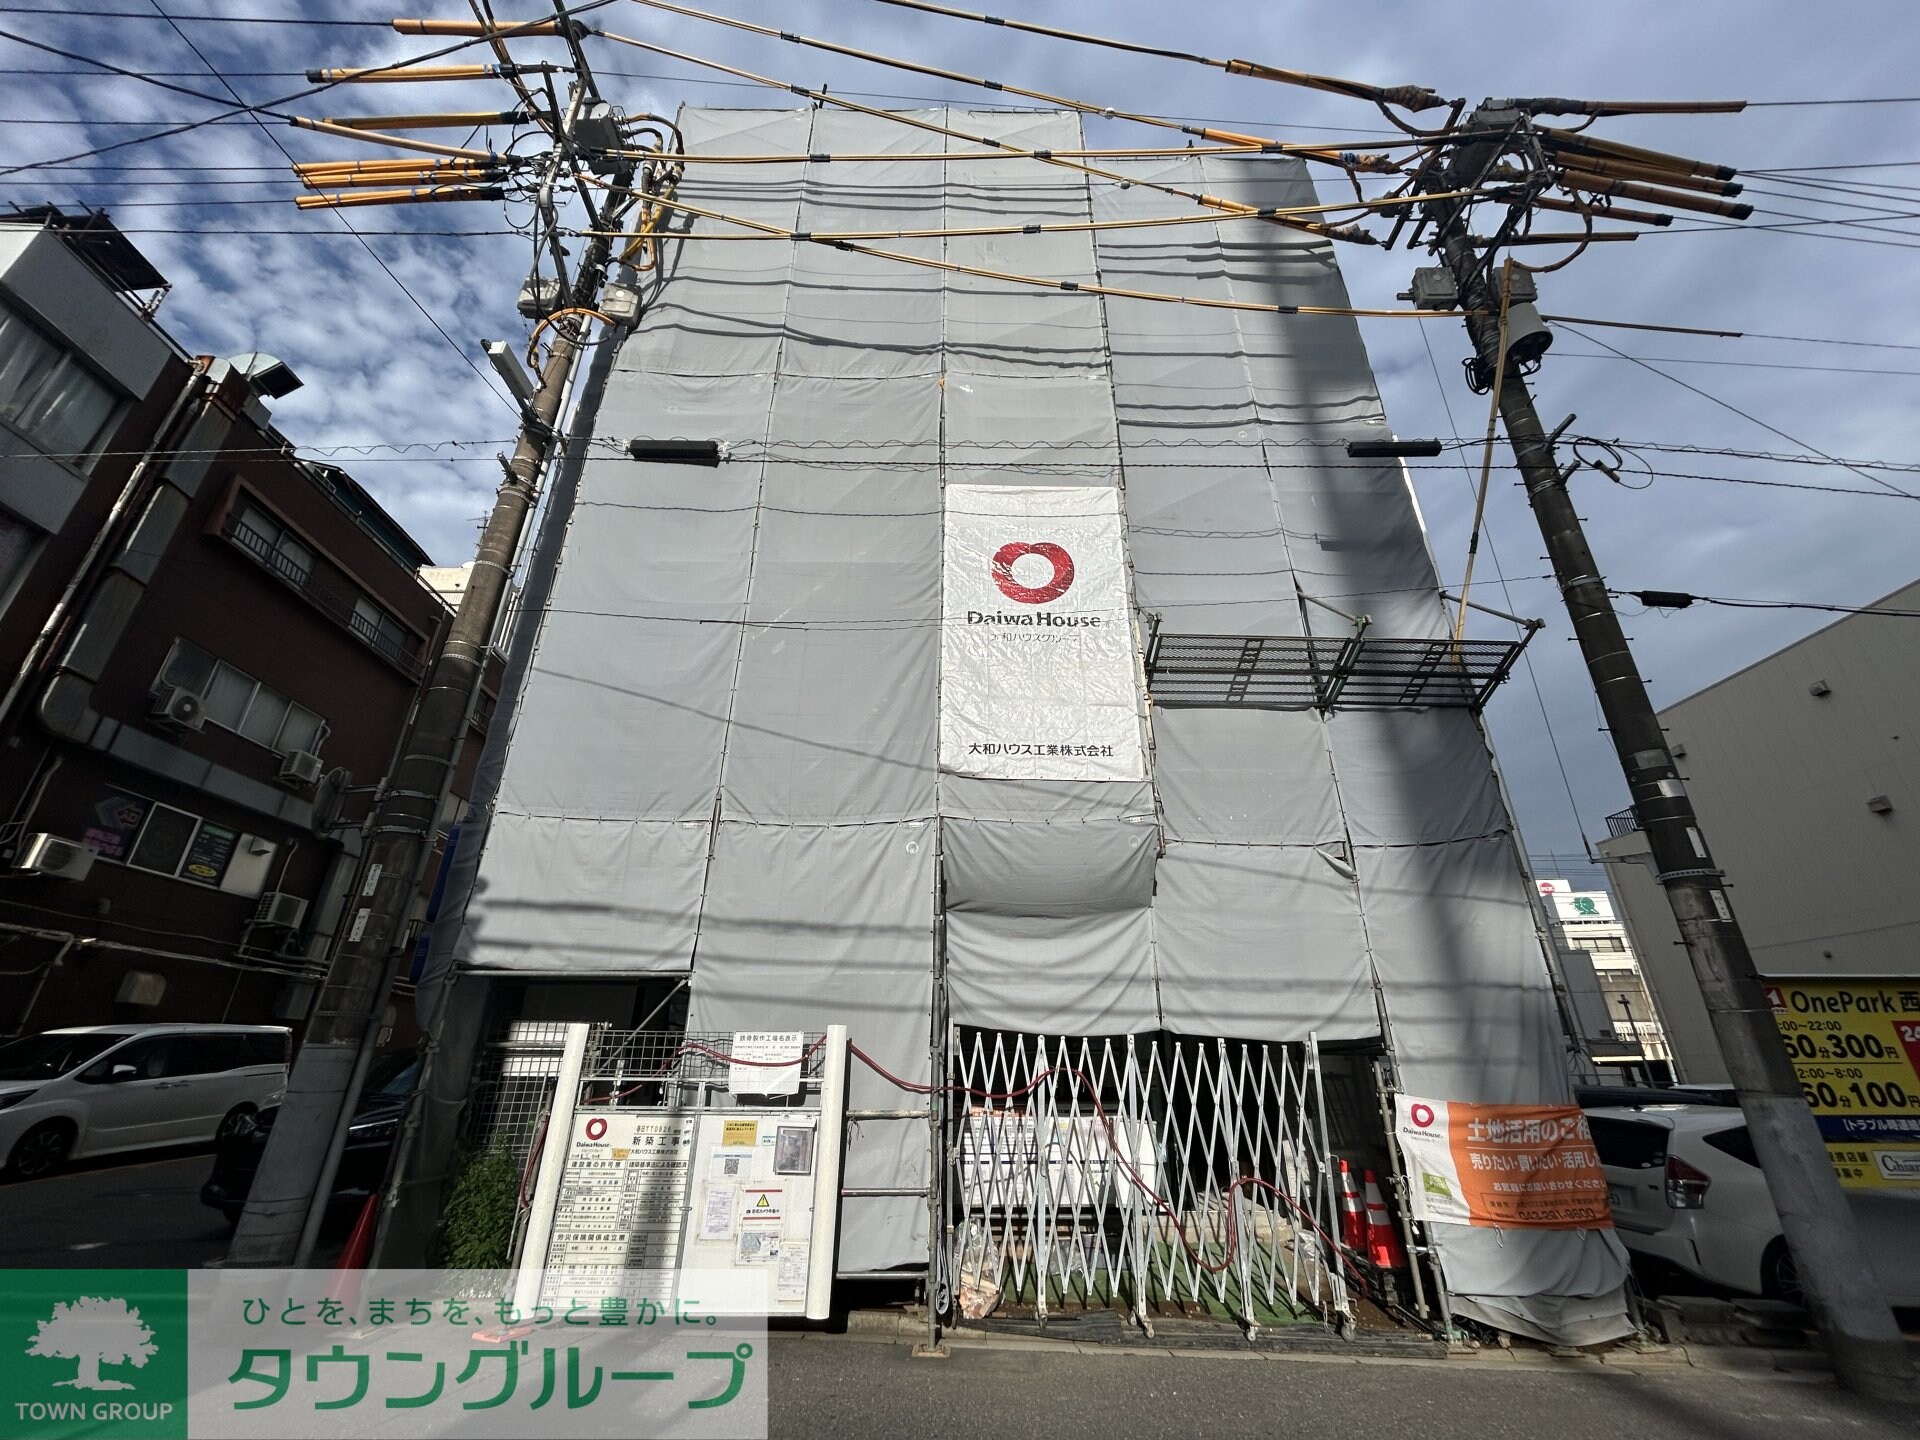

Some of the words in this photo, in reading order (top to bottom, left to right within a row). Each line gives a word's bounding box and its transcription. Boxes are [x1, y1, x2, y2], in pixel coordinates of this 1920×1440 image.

[968, 743, 1114, 757] 大和ハウス工業株式会社
[1791, 991, 1897, 1014] OnePark
[632, 1136, 681, 1146] 新築工事
